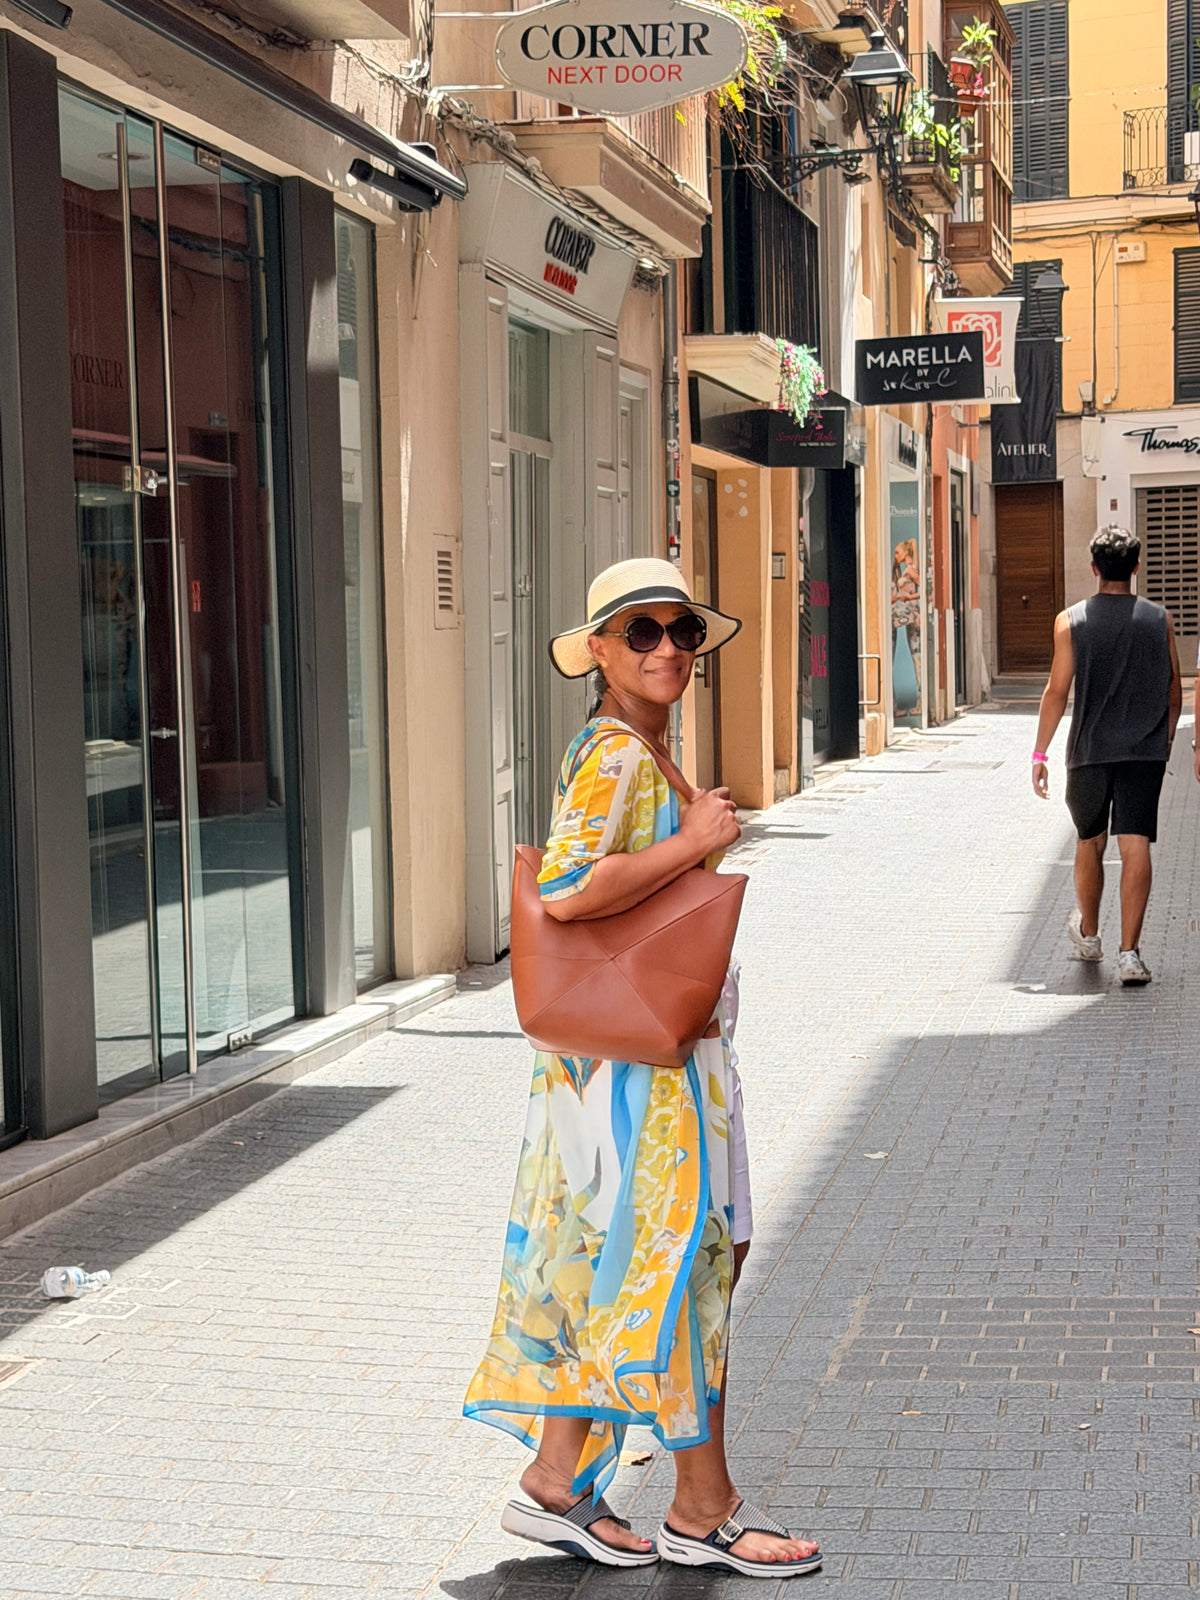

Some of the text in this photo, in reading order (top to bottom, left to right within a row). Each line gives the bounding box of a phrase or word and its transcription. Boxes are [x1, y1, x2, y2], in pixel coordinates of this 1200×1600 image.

[520, 21, 713, 61] CORNER
[547, 64, 683, 85] NEXT DOOR
[544, 215, 596, 275] CORNER
[866, 345, 972, 369] MARELLA
[70, 351, 123, 389] ORNER
[916, 368, 929, 377] BY
[996, 442, 1052, 458] ATELIER
